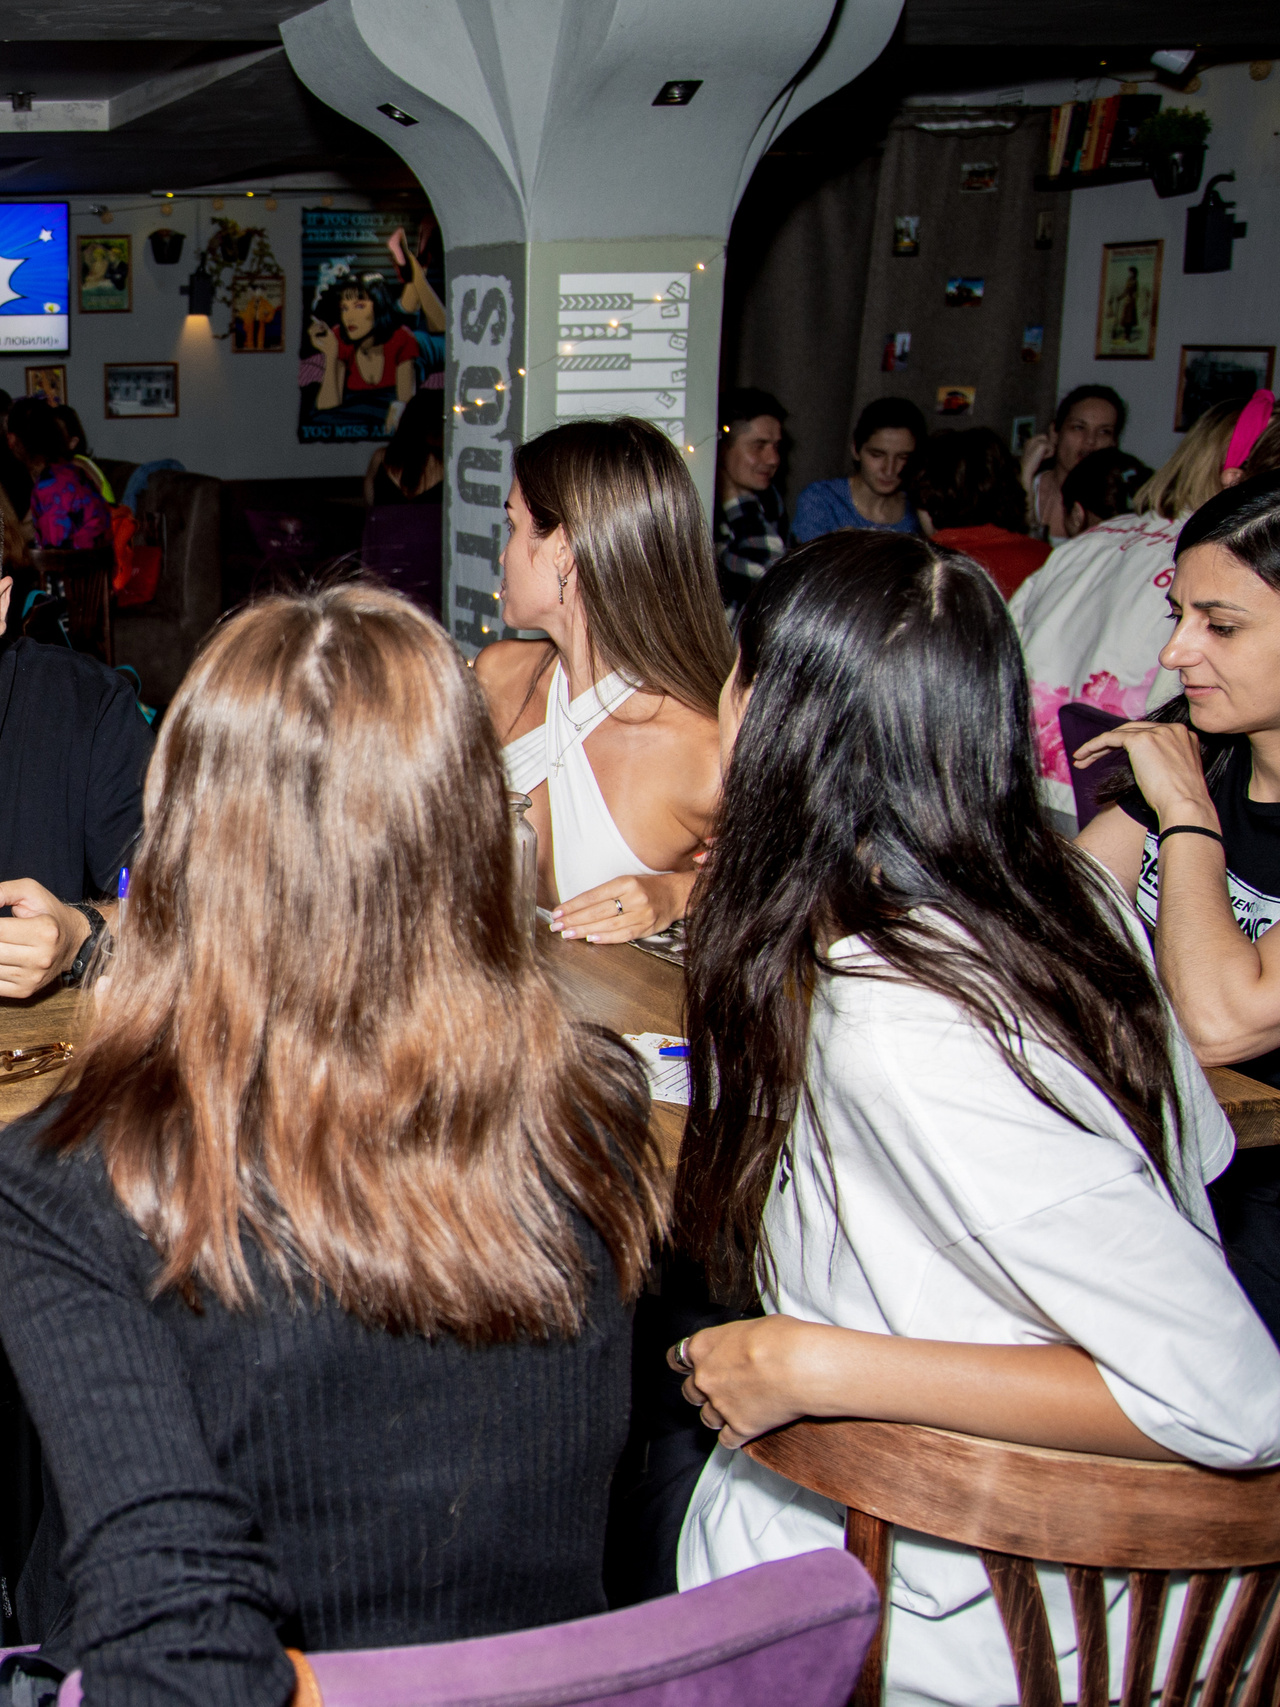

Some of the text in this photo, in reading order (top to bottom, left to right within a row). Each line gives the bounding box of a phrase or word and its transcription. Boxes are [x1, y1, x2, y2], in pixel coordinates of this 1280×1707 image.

[323, 213, 350, 226] YOU
[351, 213, 385, 226] OBEY
[304, 229, 333, 242] THE
[4, 337, 60, 348] ЛЮБИЛИ)»
[657, 391, 677, 409] E
[301, 425, 332, 439] YOU
[334, 425, 369, 439] MISS
[455, 286, 508, 648] SOUTH
